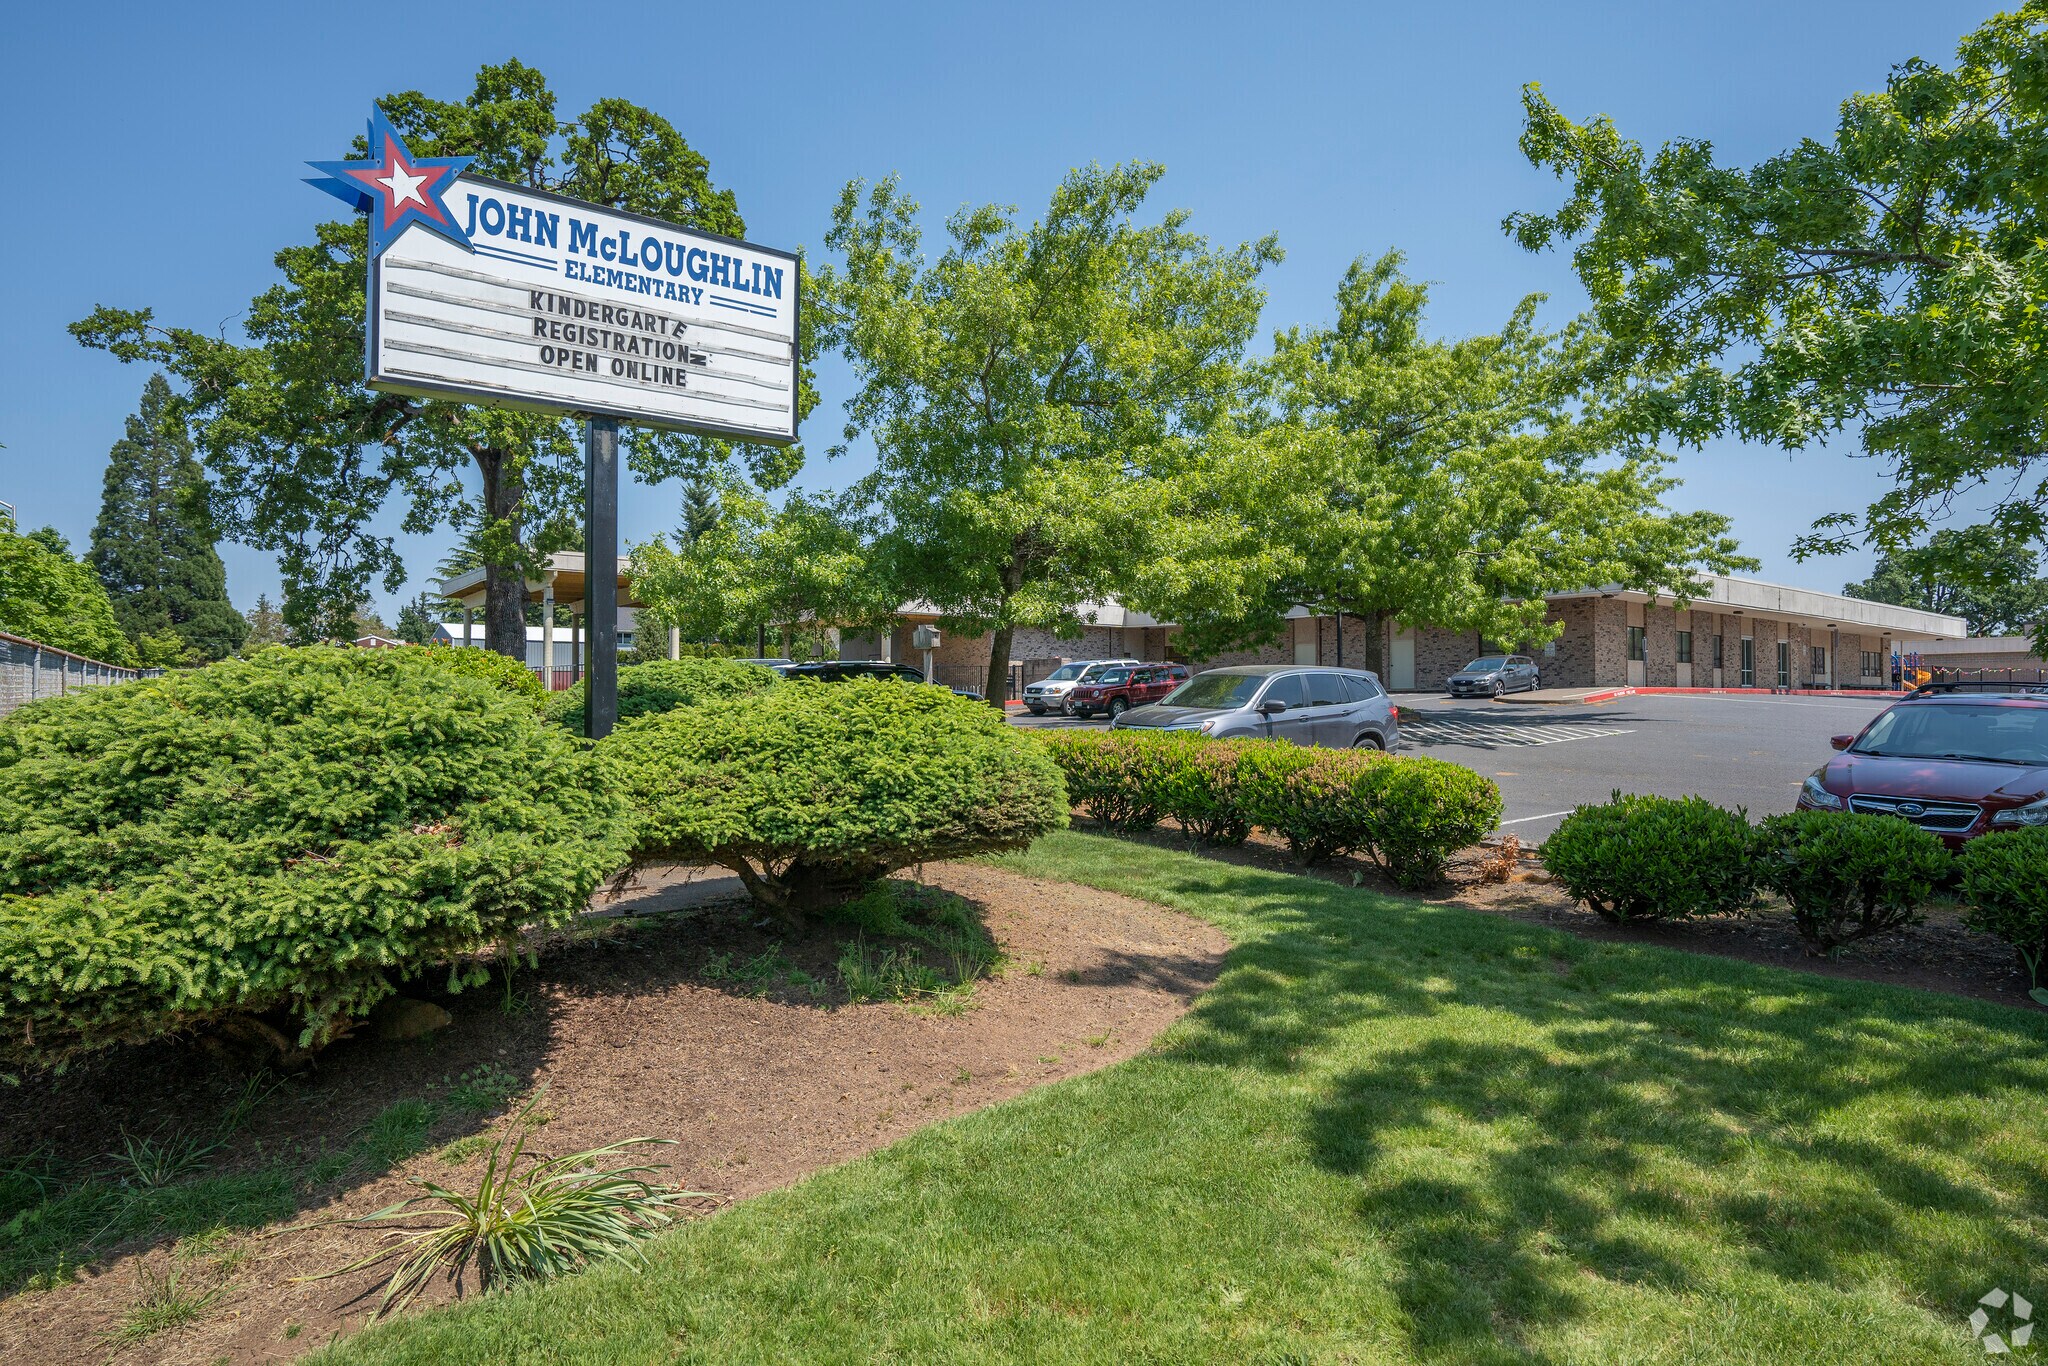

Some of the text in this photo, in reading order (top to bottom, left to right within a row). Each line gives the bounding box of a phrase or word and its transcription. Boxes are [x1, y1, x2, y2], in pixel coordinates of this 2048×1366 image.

[465, 193, 784, 300] JOHN McLOUGHLIN
[565, 259, 704, 305] ELEMENTARY
[533, 317, 690, 364] REGISTRATION
[540, 345, 687, 387] OPEN ONLINE
